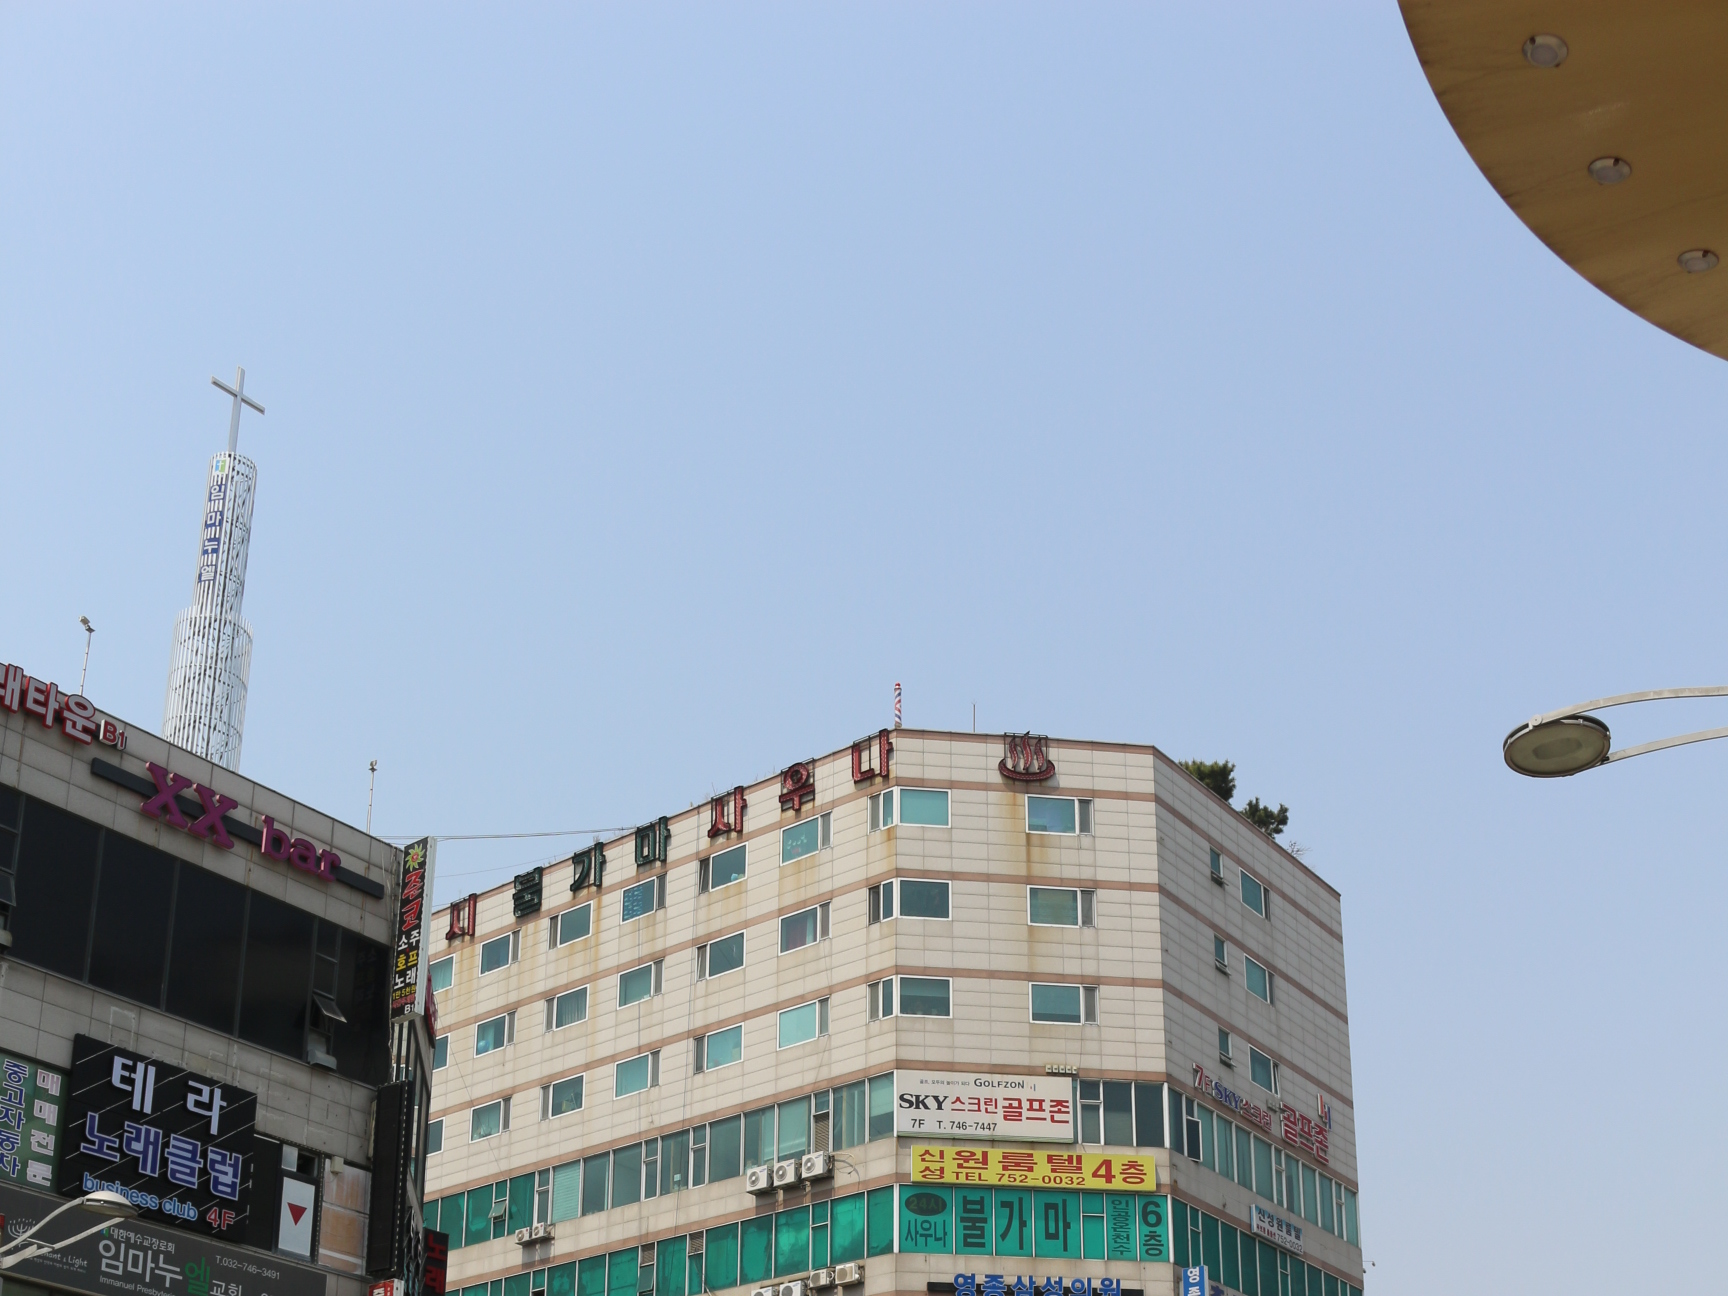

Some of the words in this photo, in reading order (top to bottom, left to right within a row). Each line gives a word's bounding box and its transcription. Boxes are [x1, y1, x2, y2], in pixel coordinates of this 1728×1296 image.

[200, 485, 226, 581] 임마누엘
[99, 719, 127, 750] B1
[708, 729, 893, 838] 사우나
[141, 761, 239, 849] XX
[261, 814, 341, 882] bar
[397, 929, 420, 951] 소주
[395, 949, 418, 972] 호프
[393, 968, 416, 990] 노래
[973, 1077, 1025, 1090] GOLFZON
[0, 1059, 28, 1177] 중고자동차
[898, 1093, 949, 1111] SKY
[950, 1096, 998, 1114] 스크린
[1001, 1097, 1071, 1124] 골프존
[1212, 1080, 1241, 1112] SKY
[1240, 1098, 1272, 1133] 스크린
[1280, 1101, 1329, 1165] 골프존
[27, 1069, 61, 1187] 매매전문
[910, 1118, 925, 1129] 7F
[936, 1120, 946, 1130] T.
[950, 1120, 998, 1132] 746-7447
[80, 1111, 244, 1201] 노래클럽
[951, 1149, 1084, 1175] 원룸텔
[1091, 1158, 1148, 1186] 4층
[951, 1171, 988, 1182] TEL
[995, 1172, 1086, 1186] 752-0032
[162, 1197, 198, 1221] club
[206, 1206, 236, 1231] 4F
[908, 1196, 943, 1212] 24시
[904, 1218, 948, 1249] 사우나
[959, 1195, 1071, 1252] 불가마
[1141, 1200, 1164, 1257] 6층
[110, 1227, 175, 1254] 대한예수교장로회
[68, 1256, 88, 1267] Light
[98, 1239, 210, 1296] 임마누엘
[215, 1255, 280, 1280] T.032-746-3491
[99, 1275, 135, 1291] Immanuel
